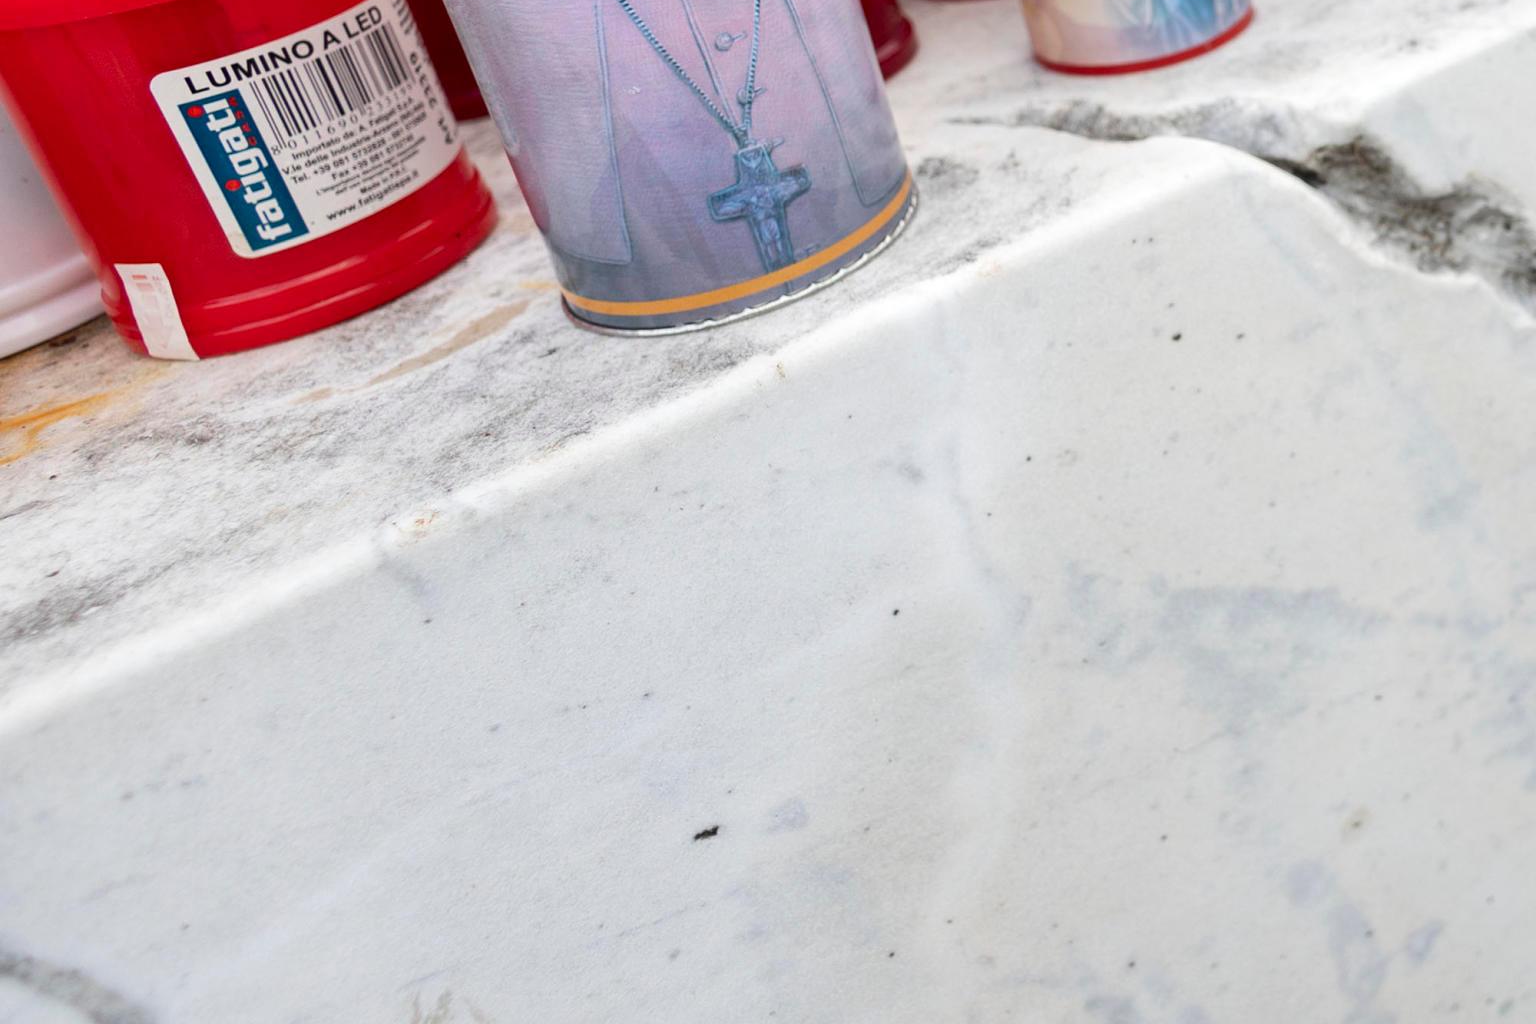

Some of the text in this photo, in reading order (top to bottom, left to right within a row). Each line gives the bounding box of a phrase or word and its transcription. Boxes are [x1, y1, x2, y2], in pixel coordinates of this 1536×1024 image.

[185, 39, 315, 95] LUMINO
[323, 30, 341, 50] A
[343, 5, 382, 40] LED
[292, 137, 341, 161] Importato
[304, 154, 329, 168] delle
[187, 97, 292, 241] fatigati
[291, 174, 310, 185] Tel.
